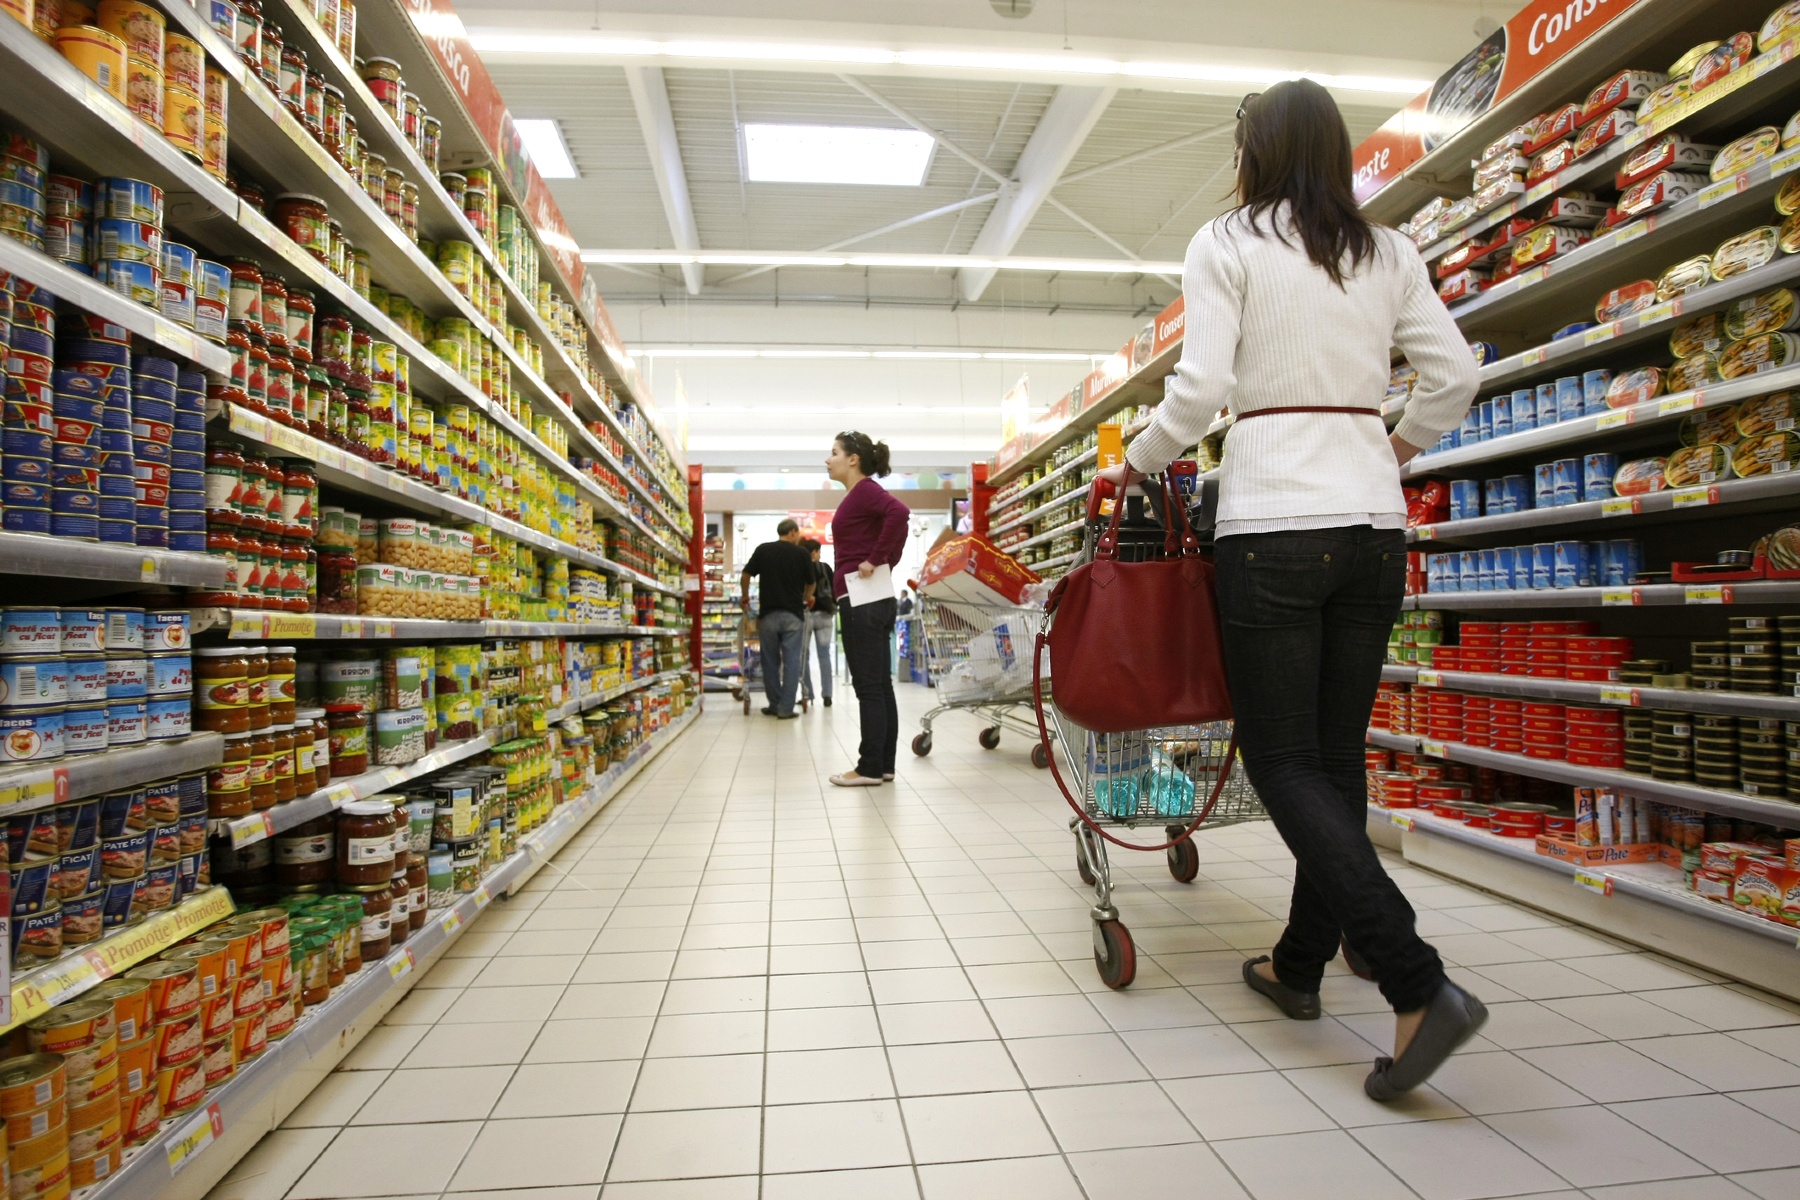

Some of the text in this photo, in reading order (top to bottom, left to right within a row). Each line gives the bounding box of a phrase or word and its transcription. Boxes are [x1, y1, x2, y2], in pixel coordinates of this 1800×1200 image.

[1528, 0, 1604, 56] Cons
[1159, 313, 1186, 342] Conser
[1605, 847, 1630, 862] Pate
[105, 921, 173, 966] Promotie
